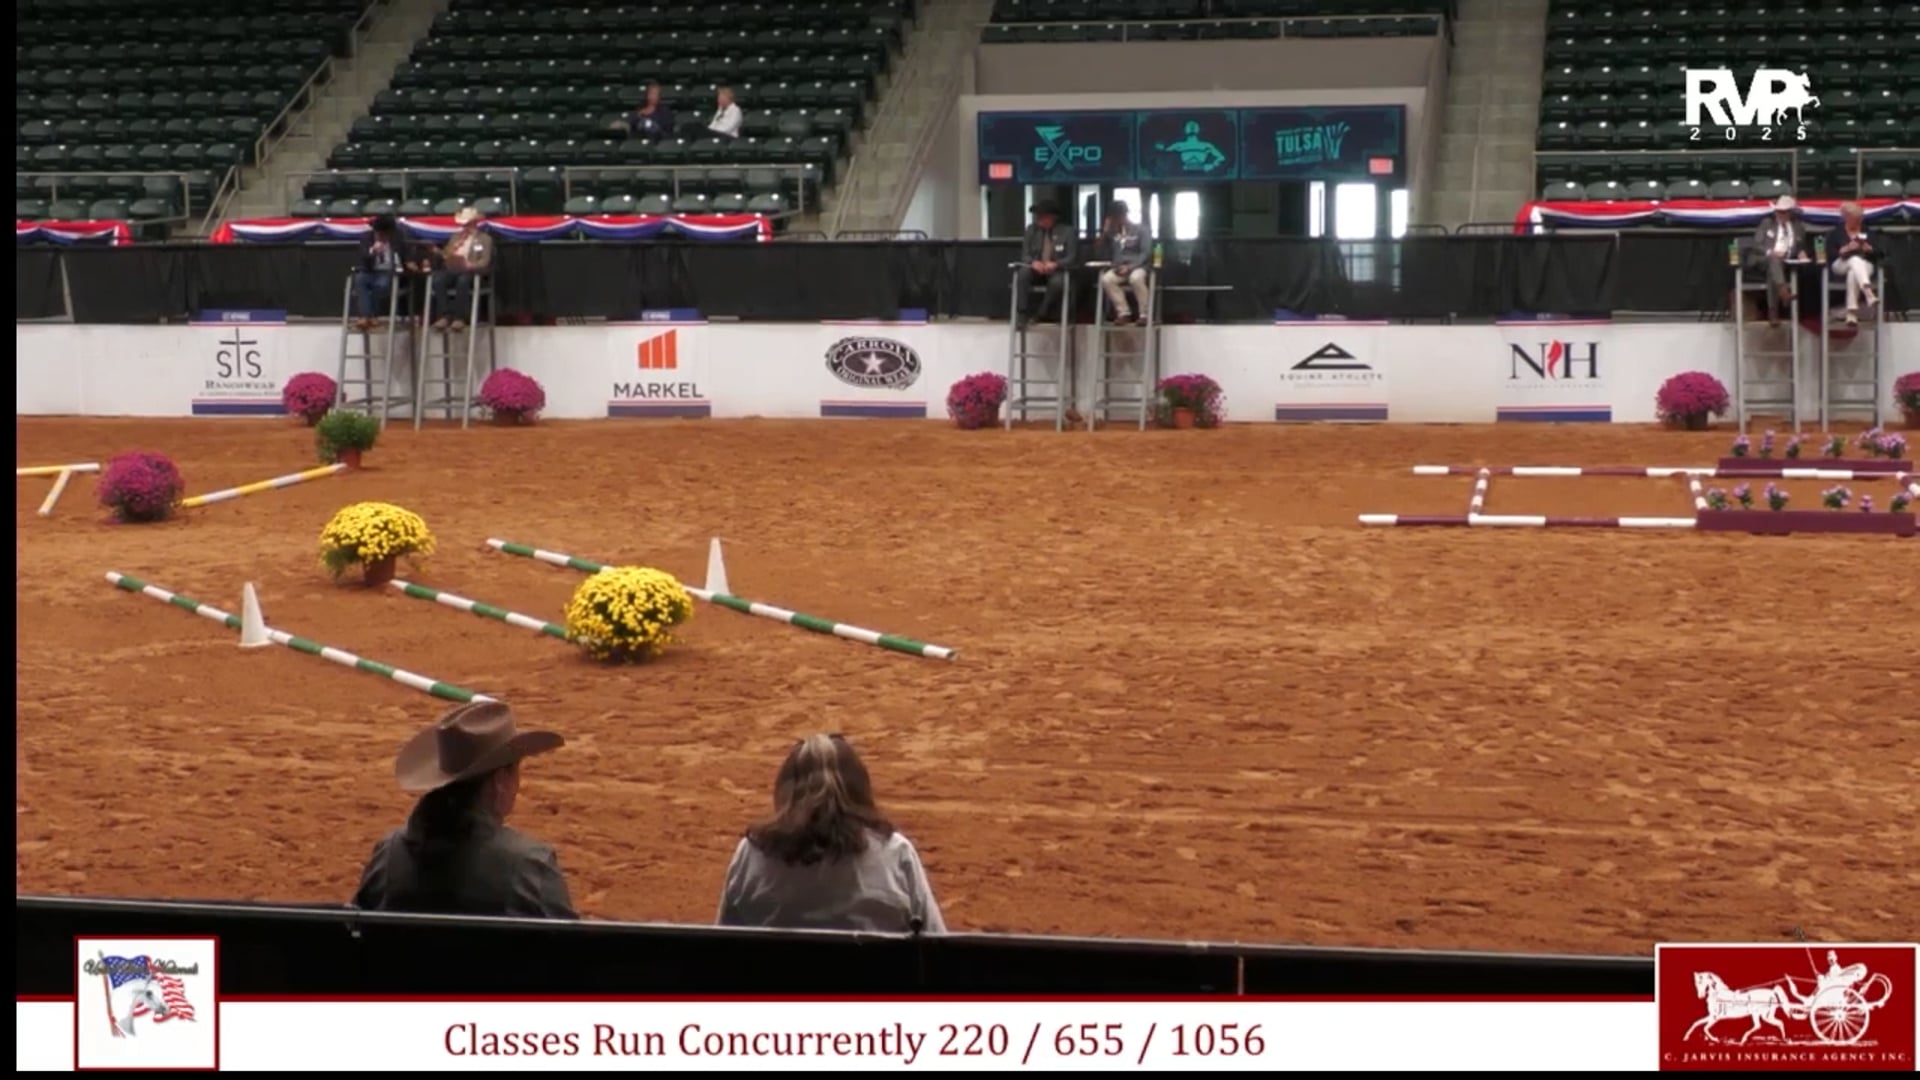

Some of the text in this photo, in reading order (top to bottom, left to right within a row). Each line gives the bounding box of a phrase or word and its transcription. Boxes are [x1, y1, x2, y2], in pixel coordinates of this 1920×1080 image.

[1034, 140, 1102, 170] EXPO
[1275, 131, 1323, 156] TULSA
[833, 340, 916, 367] CARROLL
[613, 382, 704, 398] MARKEL
